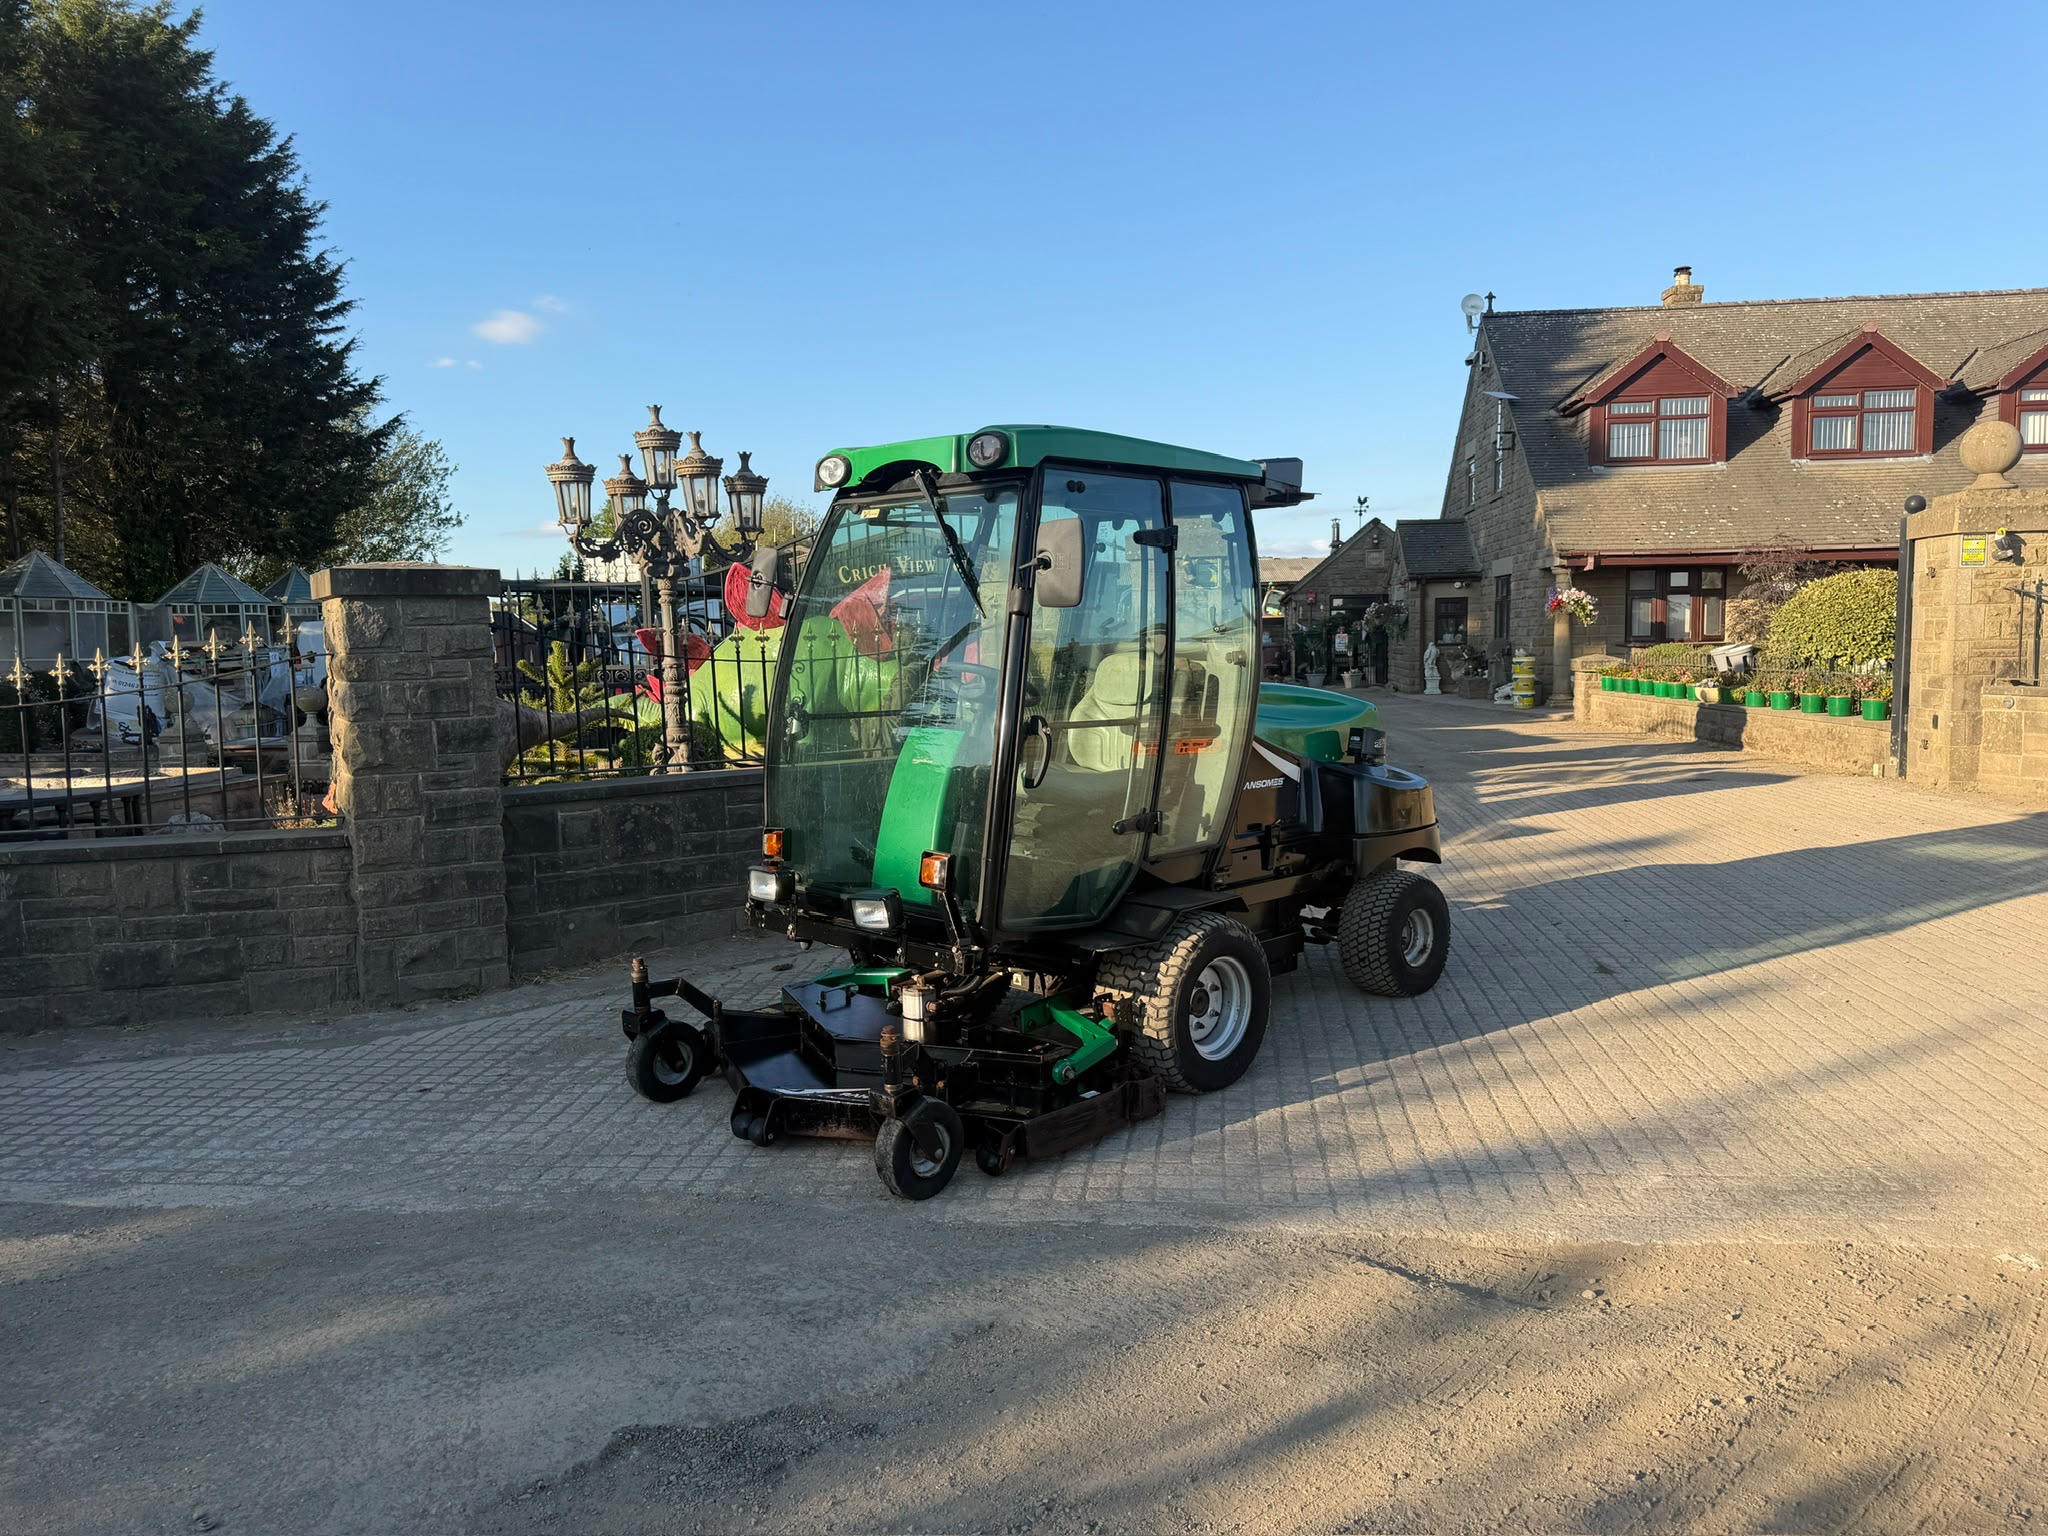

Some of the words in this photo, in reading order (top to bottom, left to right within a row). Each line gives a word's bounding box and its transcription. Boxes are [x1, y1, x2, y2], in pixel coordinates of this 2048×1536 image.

[838, 564, 887, 583] CRICH
[896, 556, 936, 573] VIEW
[1243, 778, 1285, 790] ANSOMES
